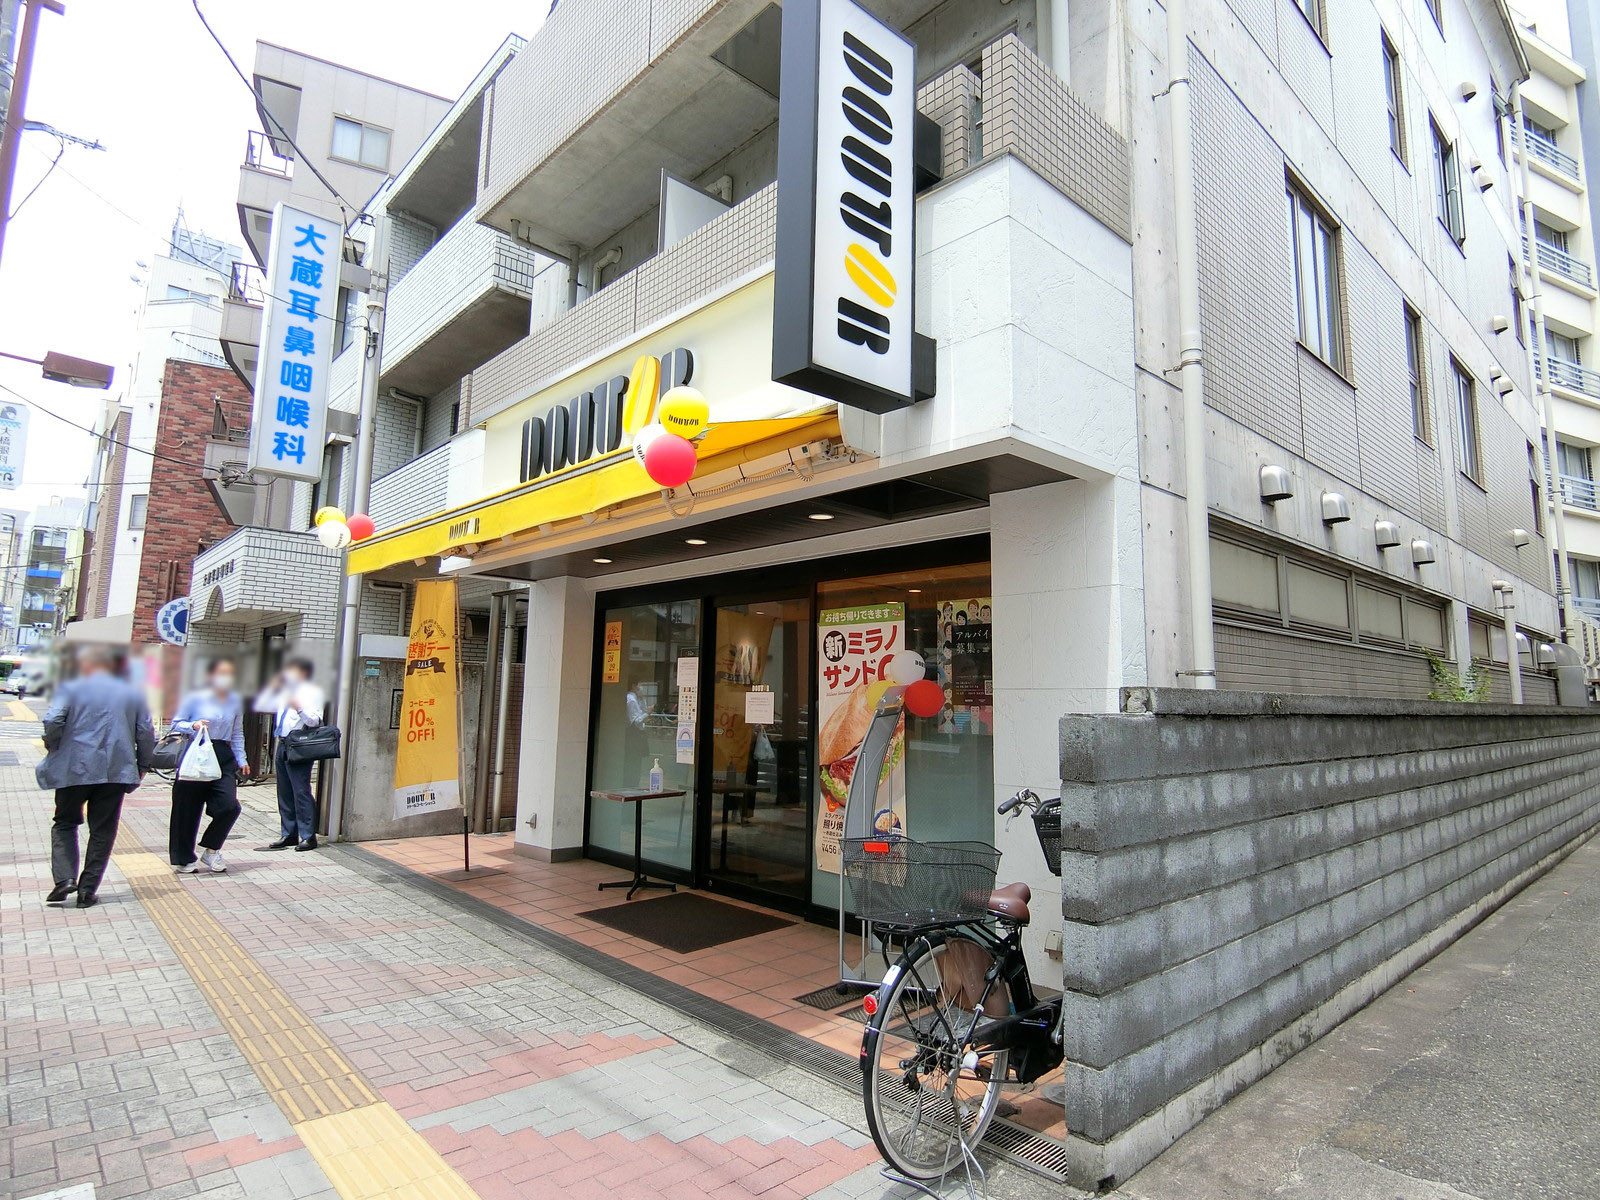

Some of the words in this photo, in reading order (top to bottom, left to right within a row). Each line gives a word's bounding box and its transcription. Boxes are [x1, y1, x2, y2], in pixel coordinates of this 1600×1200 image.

[838, 31, 898, 355] DOUTOR
[271, 223, 327, 465] 大蔵耳鼻咽喉科
[448, 517, 481, 541] DOUTOR
[825, 608, 890, 623] お持ち帰りできます
[408, 641, 450, 659] 感謝デー
[826, 634, 844, 660] 新
[848, 625, 898, 655] ミラノ
[417, 659, 433, 668] SALE
[409, 698, 435, 708] コーヒー豆
[409, 708, 435, 729] 10%
[407, 728, 435, 743] OFF!
[406, 792, 436, 805] DOUTOR
